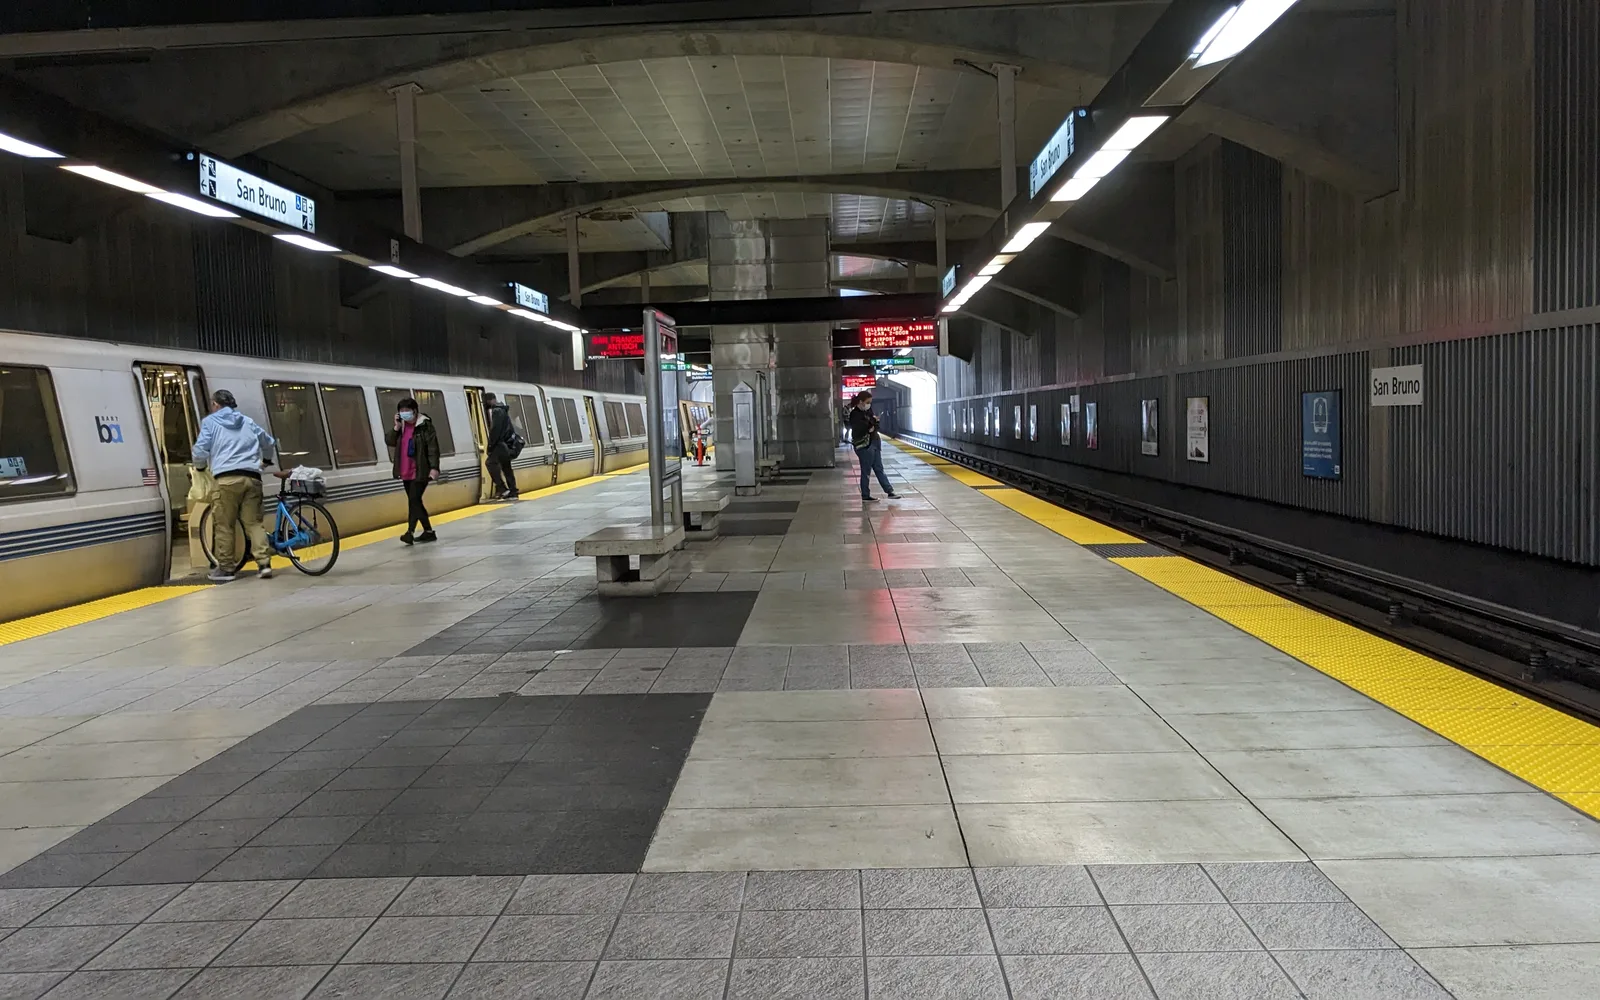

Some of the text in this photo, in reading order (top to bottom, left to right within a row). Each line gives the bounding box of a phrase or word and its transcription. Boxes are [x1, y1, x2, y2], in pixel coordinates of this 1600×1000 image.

[1048, 144, 1060, 170] Bruno
[236, 178, 287, 214] San Bruno
[1373, 376, 1420, 396] San Bruno
